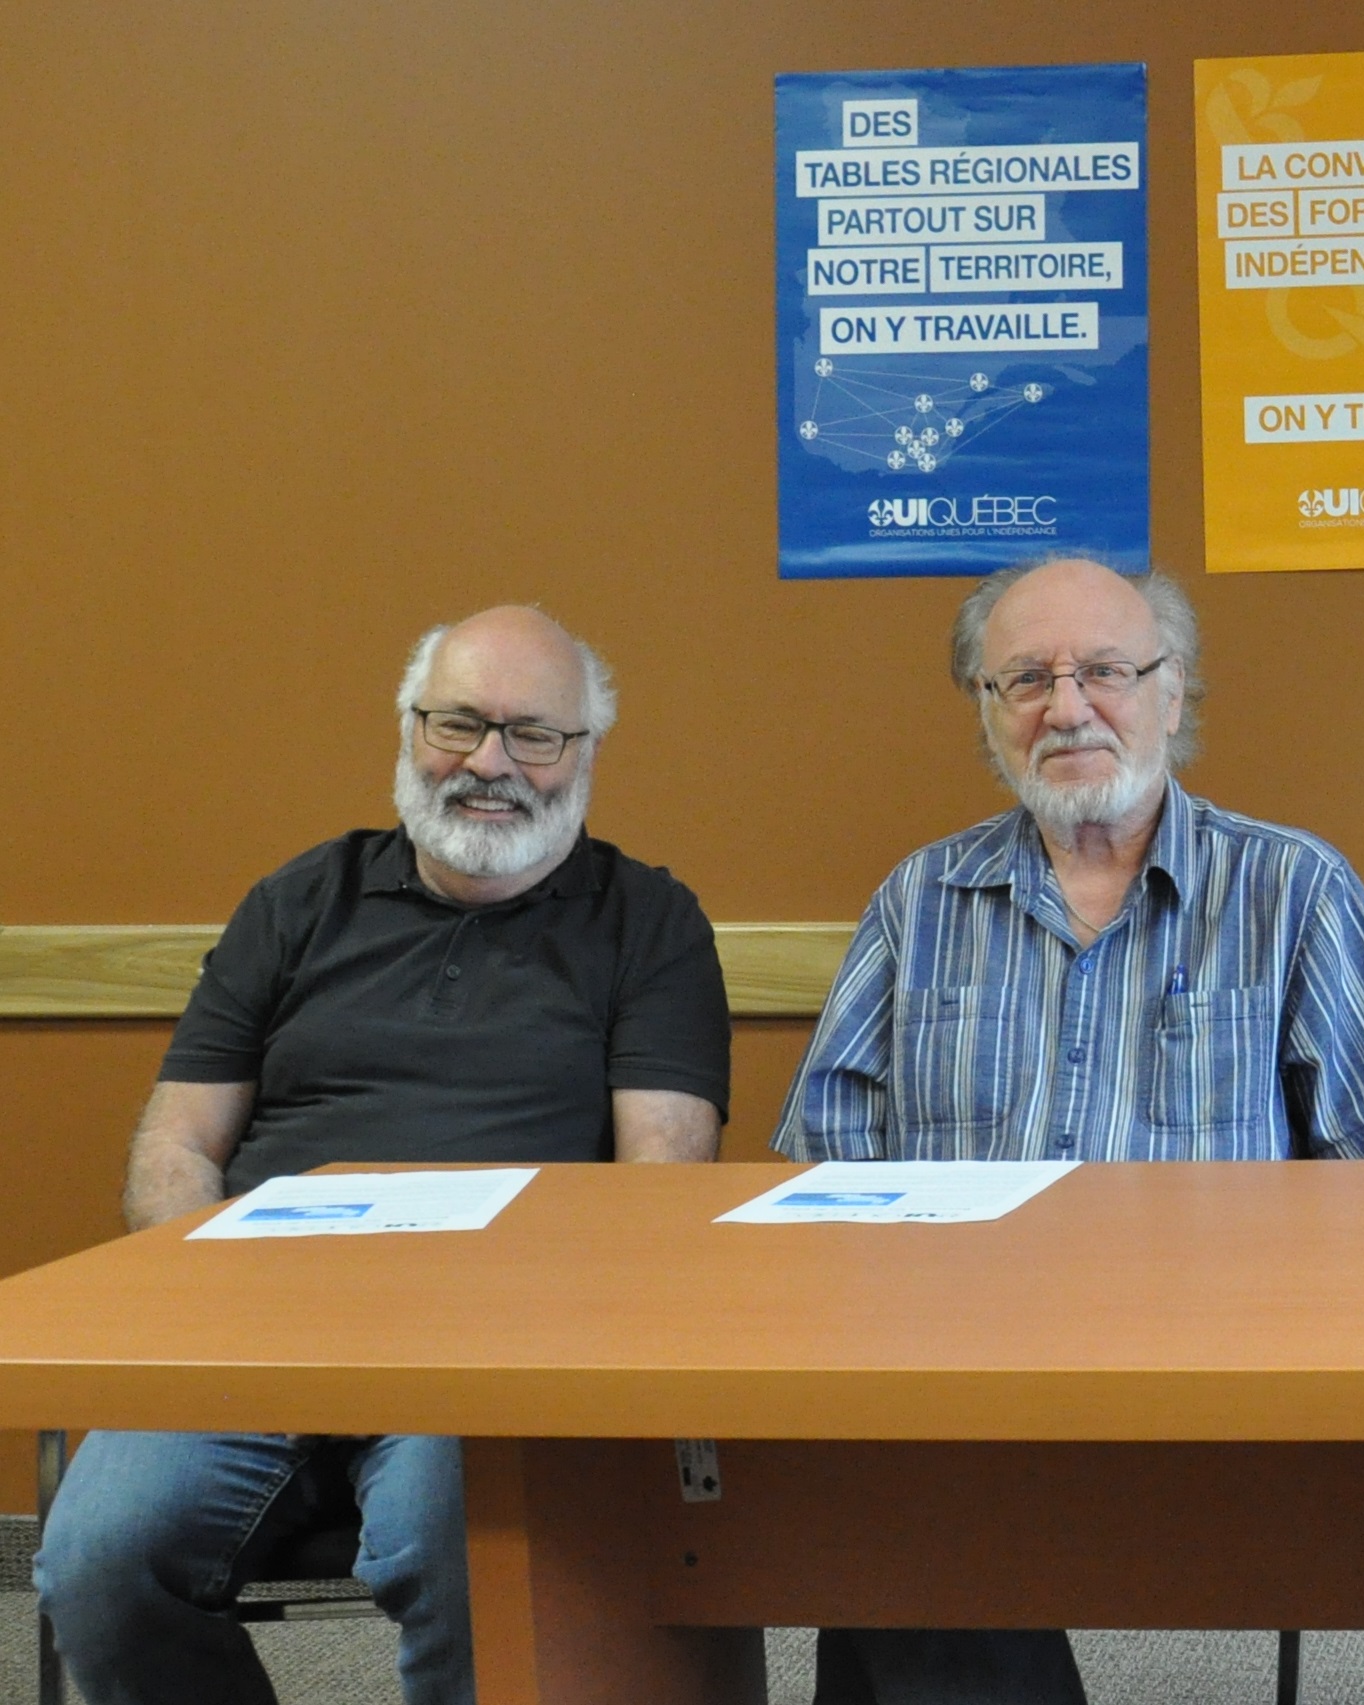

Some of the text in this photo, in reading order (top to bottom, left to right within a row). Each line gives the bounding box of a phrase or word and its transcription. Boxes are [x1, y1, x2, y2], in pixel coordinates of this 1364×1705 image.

[849, 109, 912, 138] DES
[803, 151, 1132, 188] TABLES RÉGIONALES
[1237, 155, 1277, 181] LA
[826, 204, 1037, 236] PARTOUT SUR
[1227, 200, 1289, 228] DES
[813, 253, 1112, 286] NOTRE TERRITOIRE,
[830, 312, 1088, 344] ON Y TRAVAILLE.
[1258, 403, 1306, 432] ON
[1314, 403, 1335, 430] Y
[869, 527, 936, 538] ORGANISATIONS
[937, 527, 961, 536] UNIES
[962, 526, 986, 536] POUR
